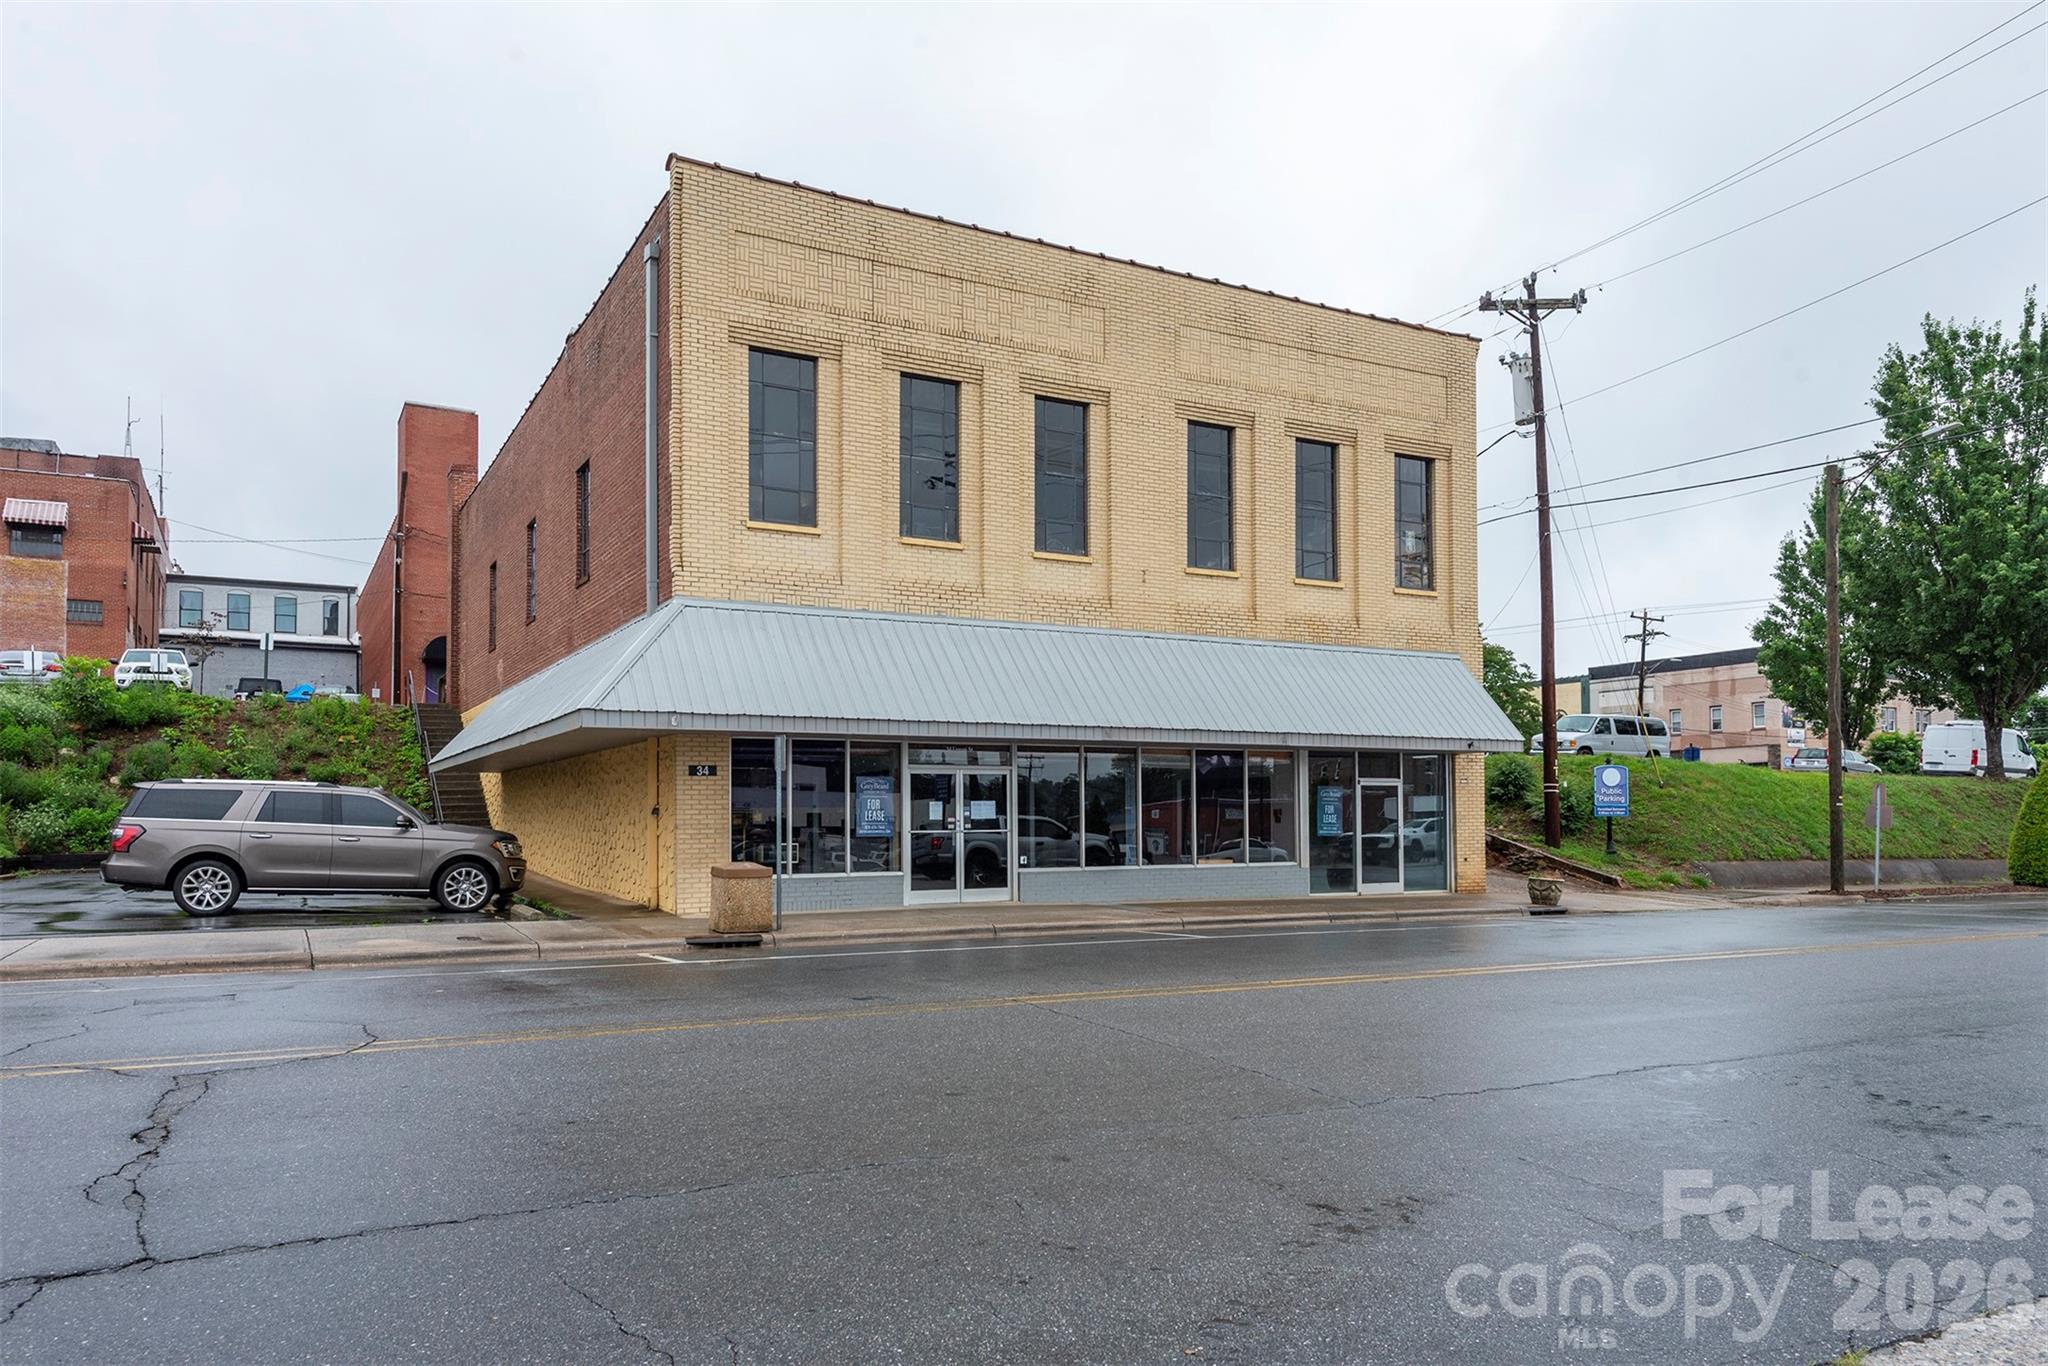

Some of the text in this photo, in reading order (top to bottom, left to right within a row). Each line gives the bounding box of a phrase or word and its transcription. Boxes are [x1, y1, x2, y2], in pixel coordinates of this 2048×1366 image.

[696, 765, 709, 776] 34
[1600, 787, 1622, 795] Public
[1598, 794, 1625, 803] Parking
[867, 799, 881, 810] FOR
[864, 810, 885, 821] LEASE
[1322, 814, 1337, 823] LEASE
